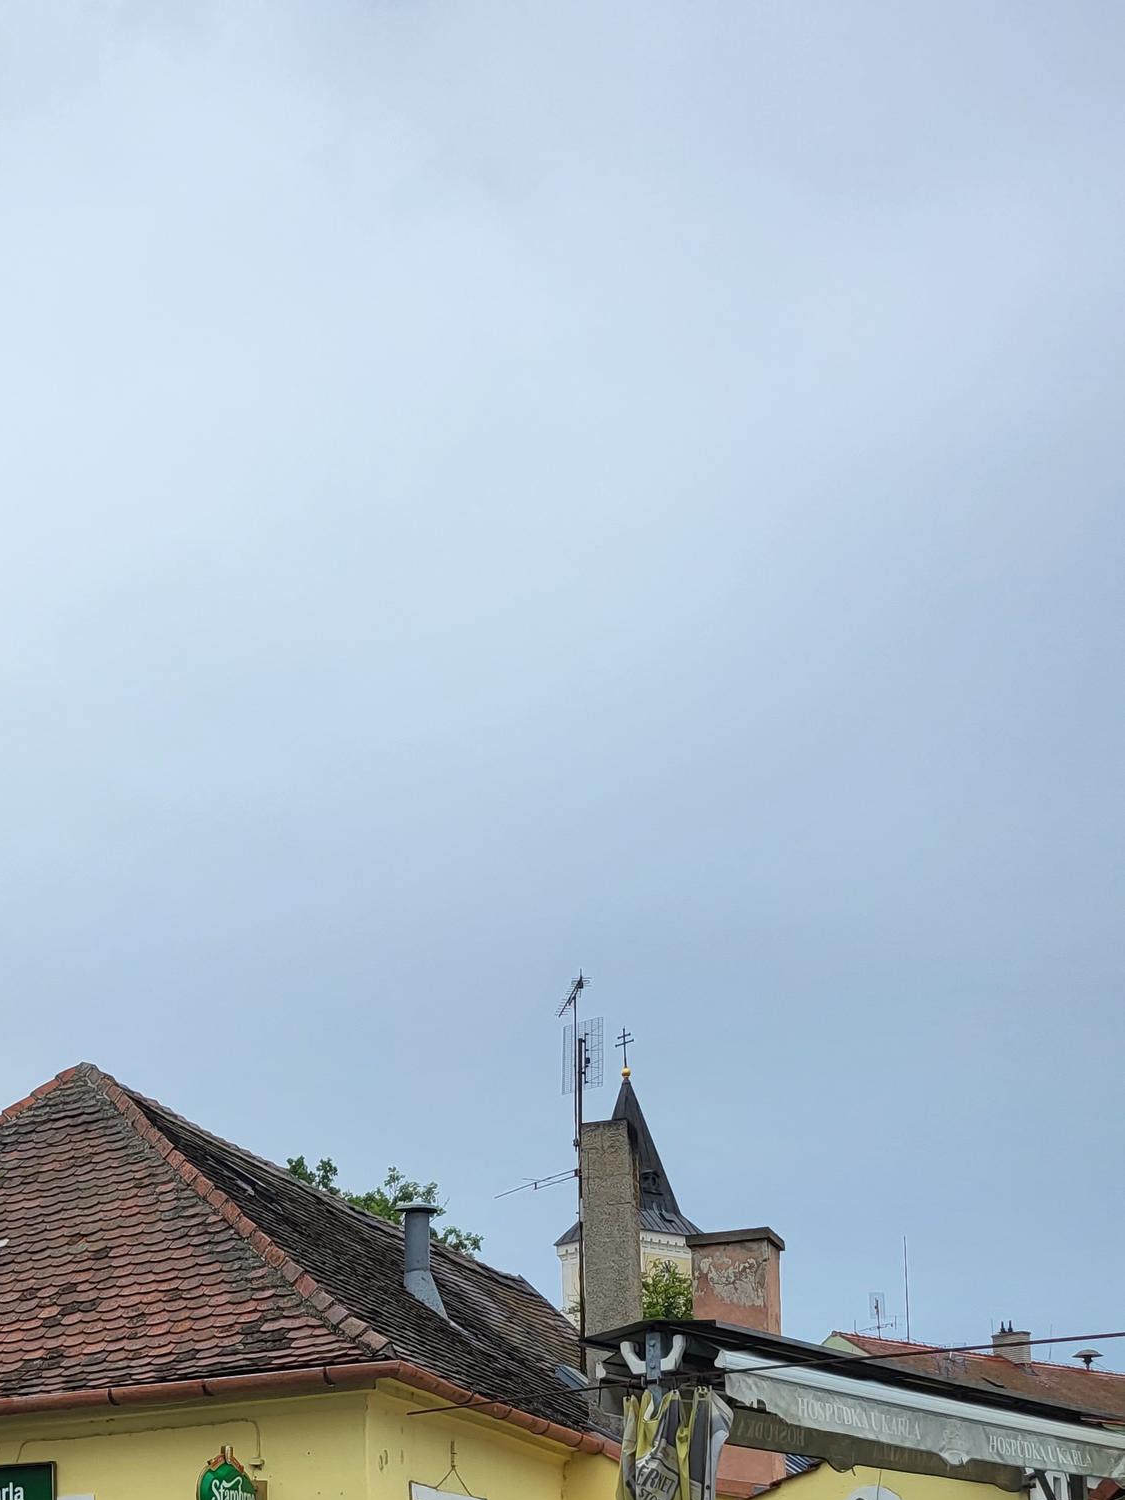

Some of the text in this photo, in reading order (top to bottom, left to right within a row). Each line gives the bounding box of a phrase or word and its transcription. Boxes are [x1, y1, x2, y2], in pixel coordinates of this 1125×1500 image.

[881, 1414, 921, 1440] KARLA
[1056, 1447, 1092, 1467] KARLA
[636, 1464, 675, 1494] ERNET
